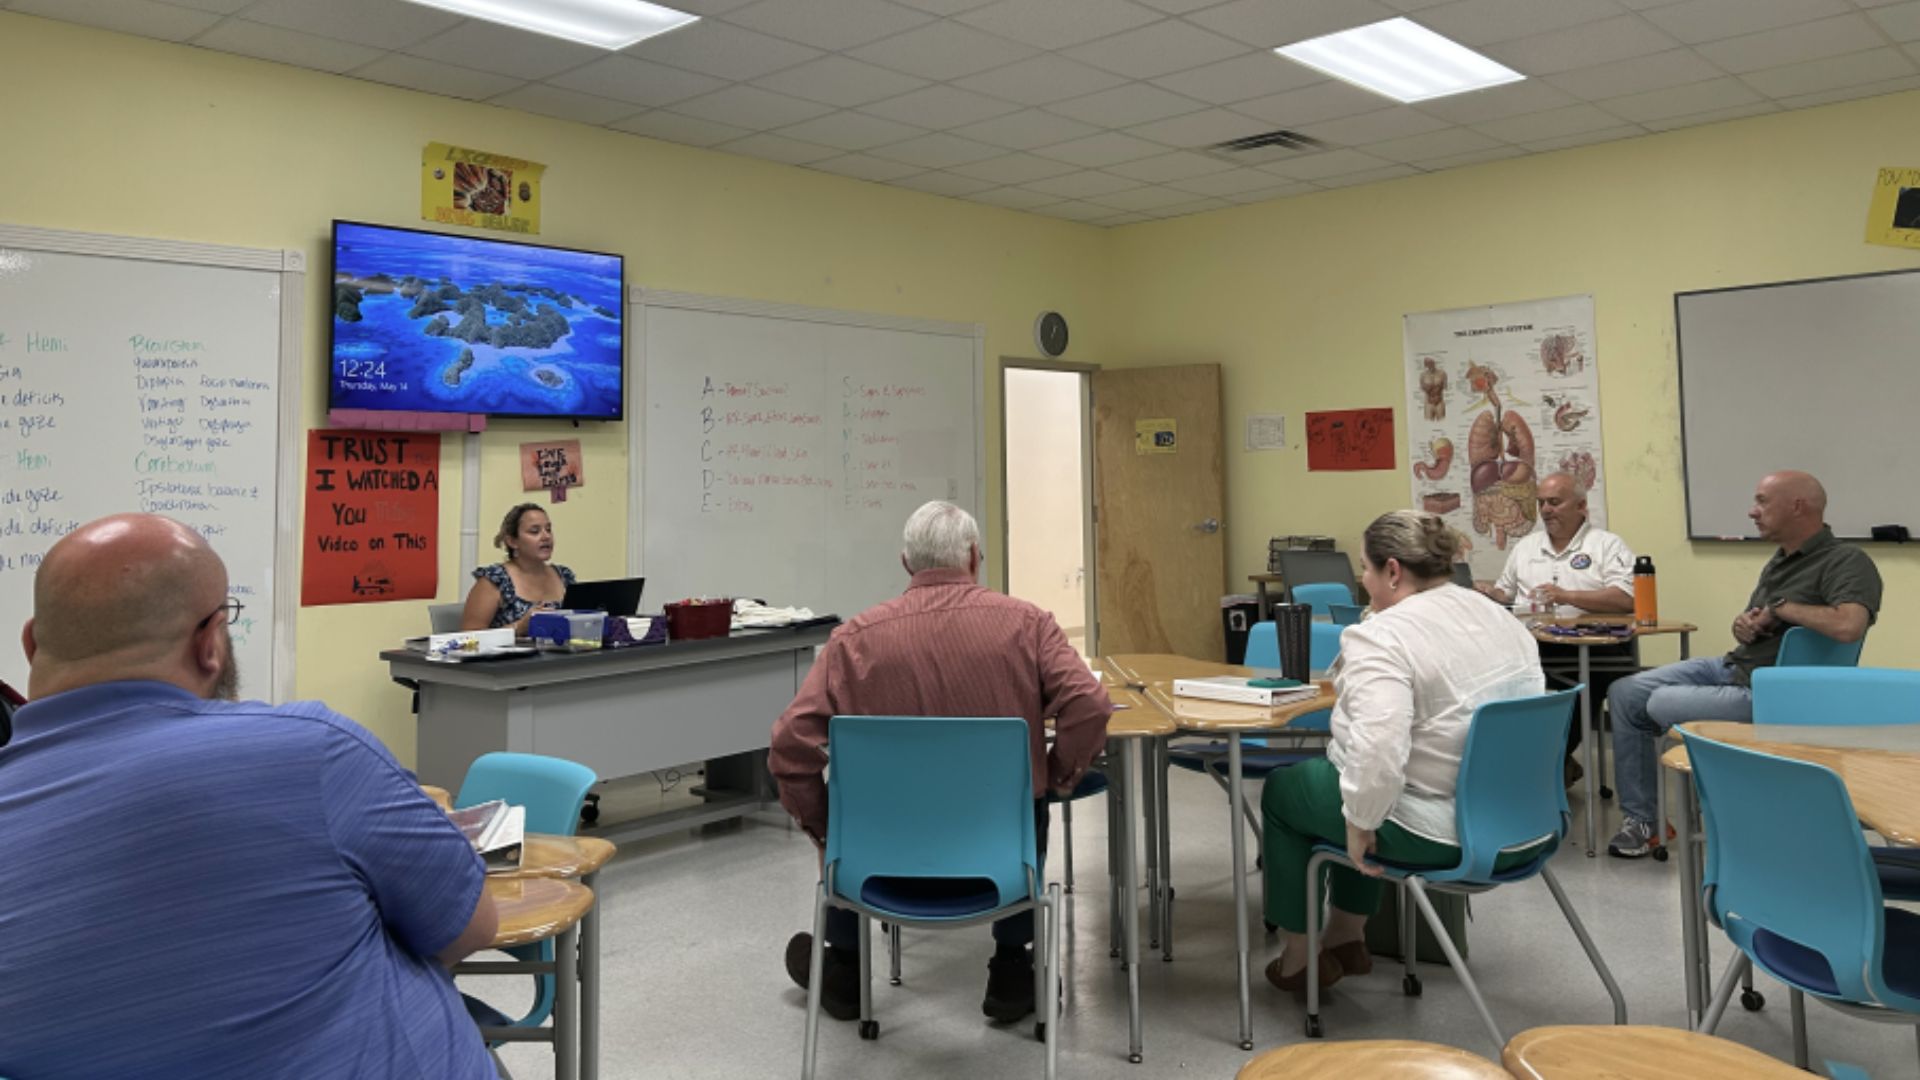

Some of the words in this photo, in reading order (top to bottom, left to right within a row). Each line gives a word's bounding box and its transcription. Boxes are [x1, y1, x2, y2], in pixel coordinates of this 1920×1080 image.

[340, 360, 386, 378] 12:24
[320, 435, 410, 465] TRUST
[315, 468, 336, 491] I
[346, 468, 420, 491] WATCHED
[424, 468, 438, 490] A
[318, 535, 358, 552] Video
[369, 537, 384, 550] on
[393, 532, 427, 550] This
